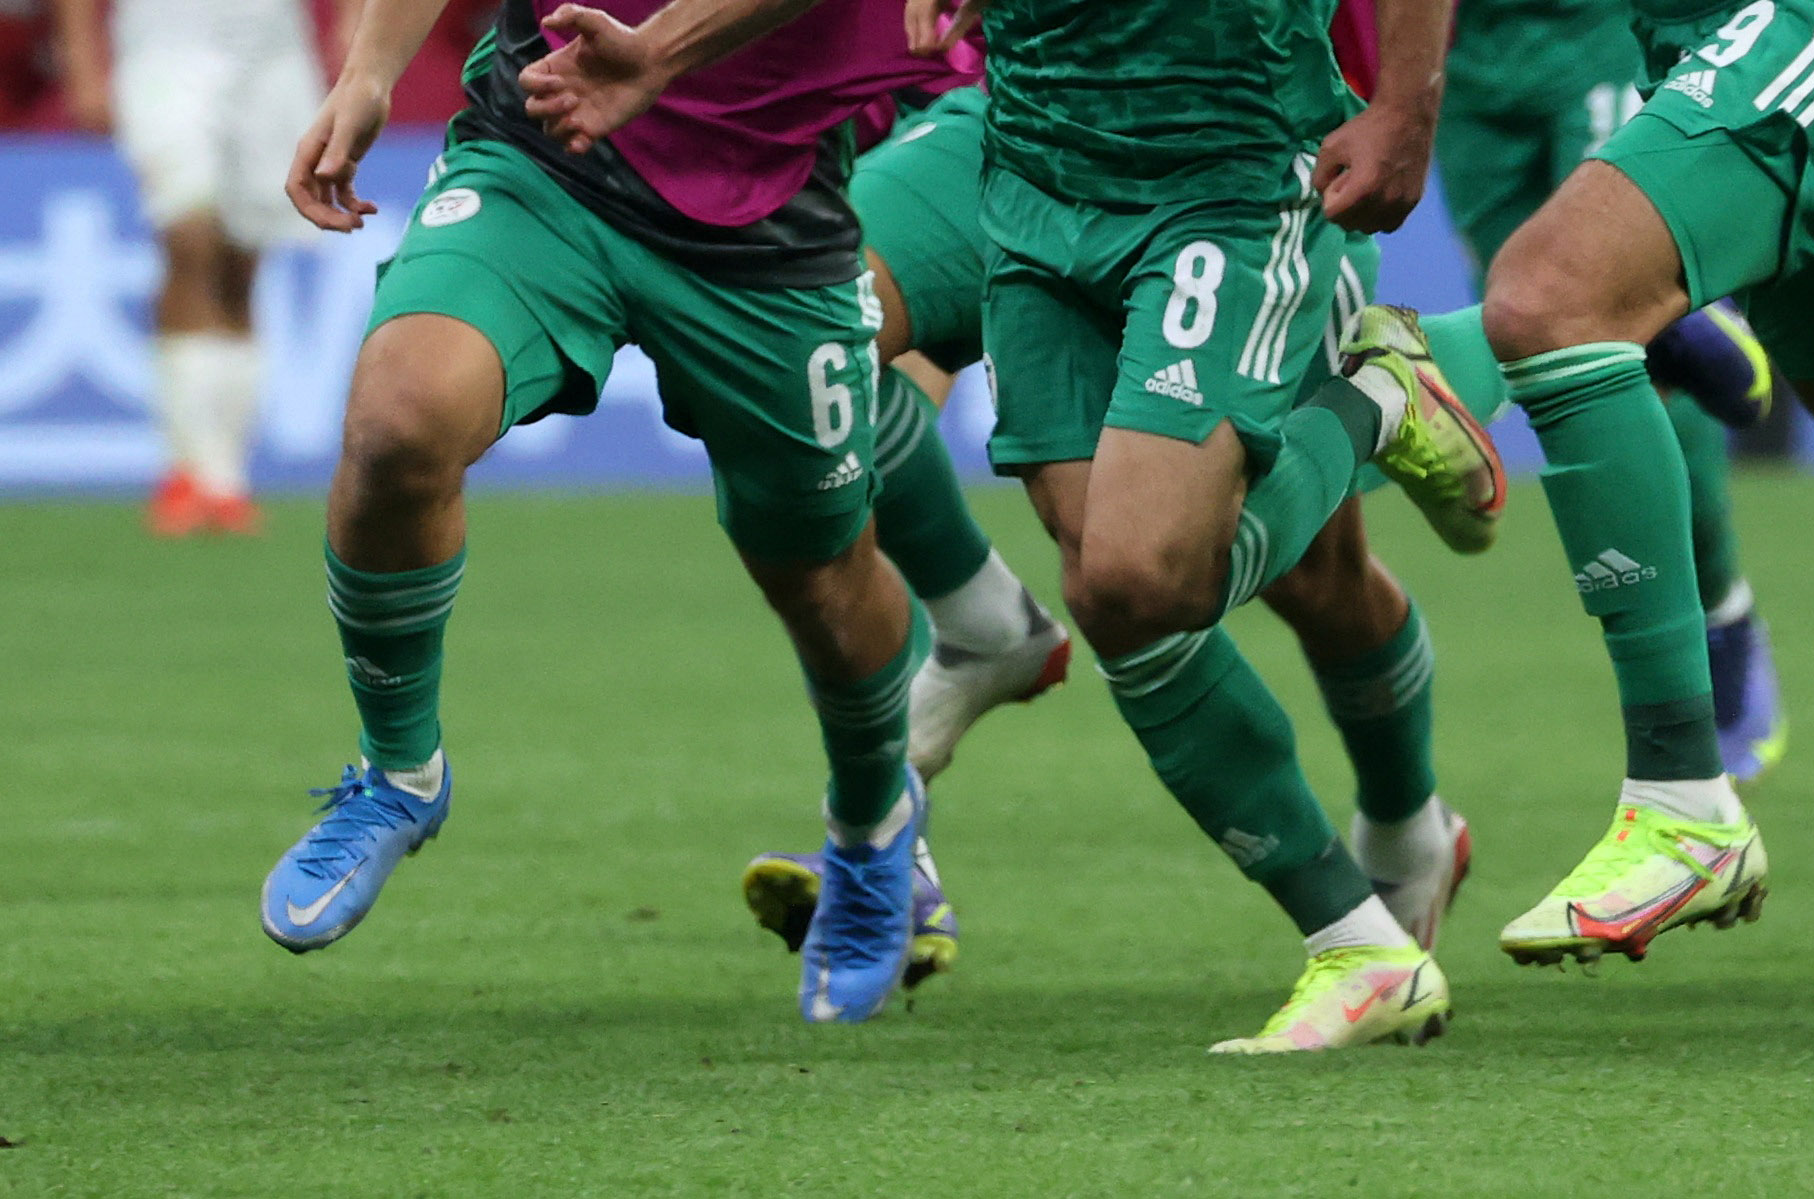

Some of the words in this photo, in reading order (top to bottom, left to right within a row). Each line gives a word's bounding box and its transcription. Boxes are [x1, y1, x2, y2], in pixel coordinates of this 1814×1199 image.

[1162, 240, 1226, 349] 8
[807, 341, 853, 448] 6
[1144, 377, 1204, 406] adidas
[1577, 565, 1658, 593] didas
